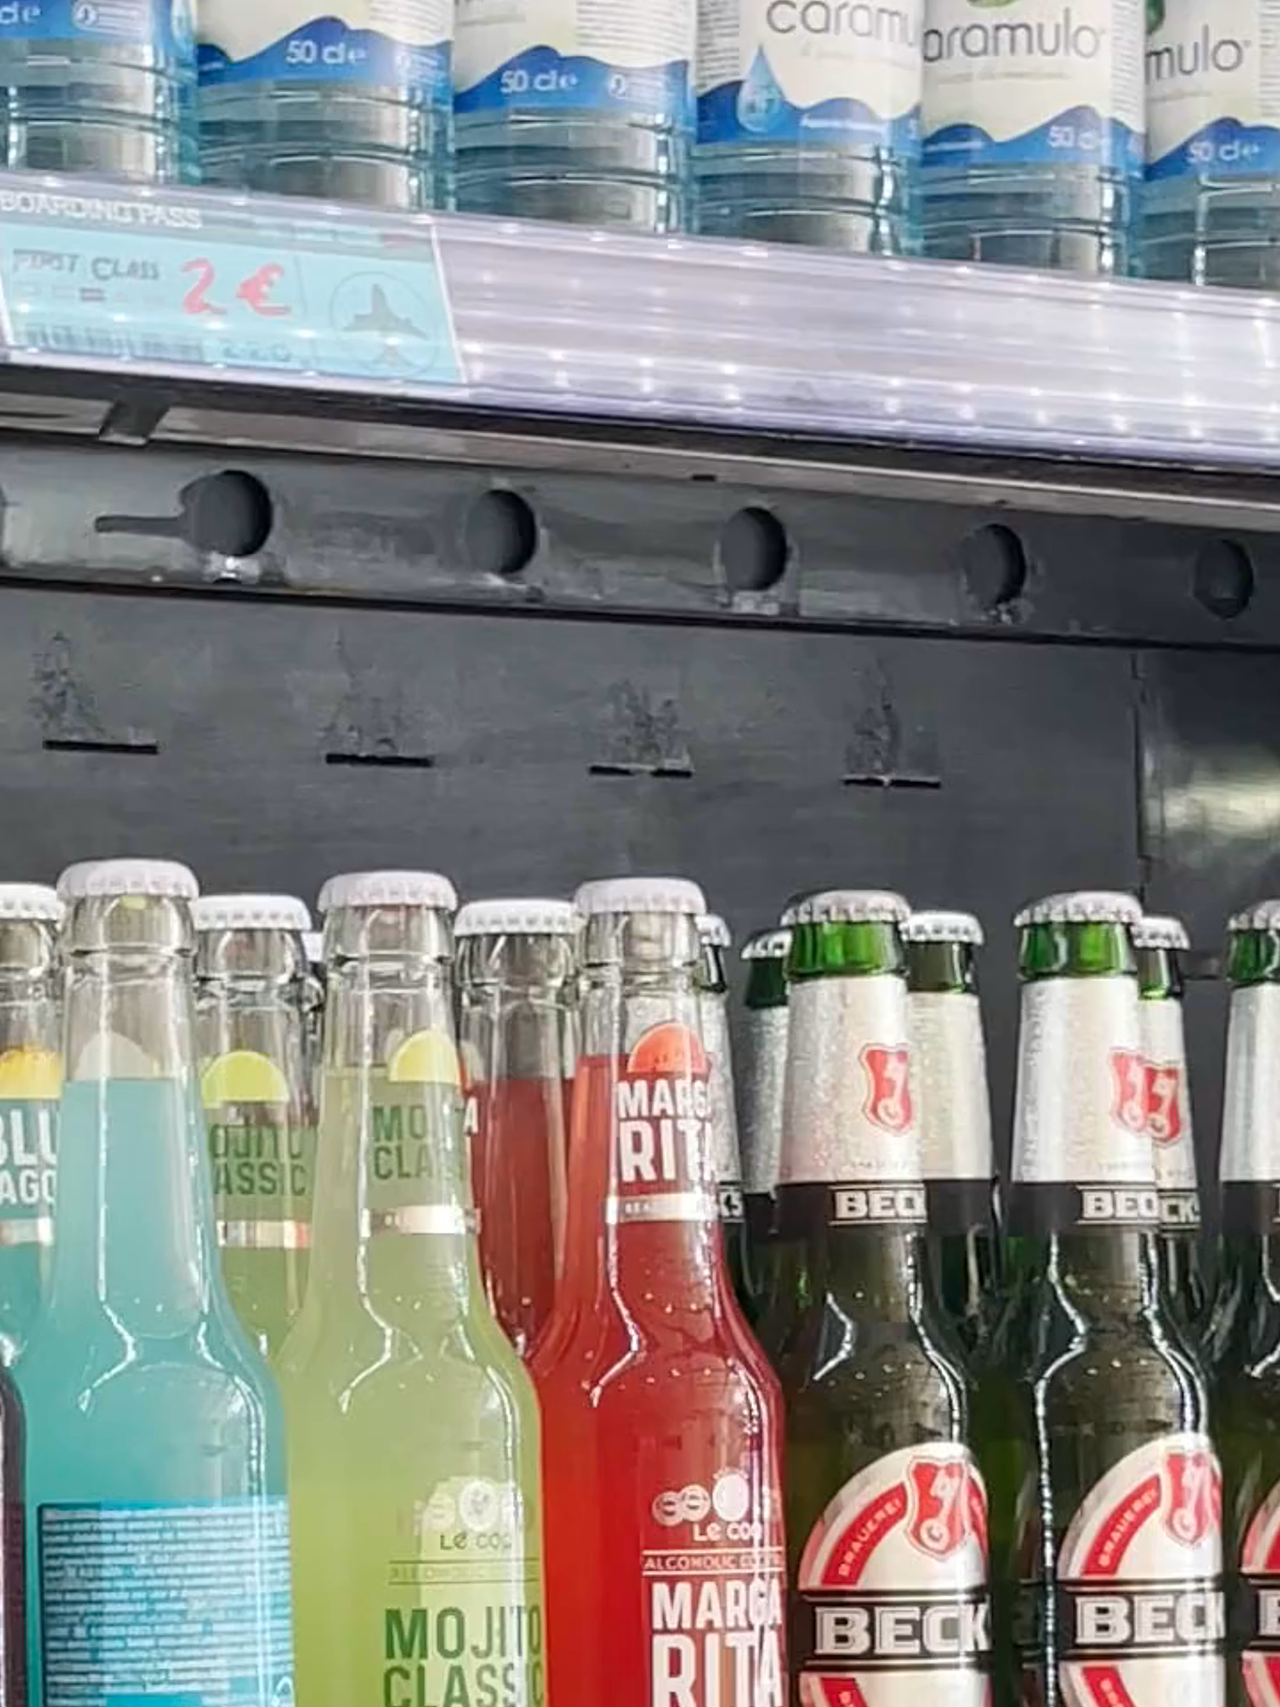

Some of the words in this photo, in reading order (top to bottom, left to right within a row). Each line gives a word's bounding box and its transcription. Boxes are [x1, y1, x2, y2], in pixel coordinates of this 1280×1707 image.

[286, 41, 316, 65] 50
[501, 71, 529, 92] 50
[0, 190, 137, 224] BOARDING
[139, 201, 202, 229] PASS
[92, 256, 160, 281] CLASS
[838, 1497, 902, 1577] BRAUEREI
[643, 1555, 738, 1572] ALCOHOLIC
[652, 1578, 782, 1631] MARGA
[384, 1605, 541, 1660] MOJITO
